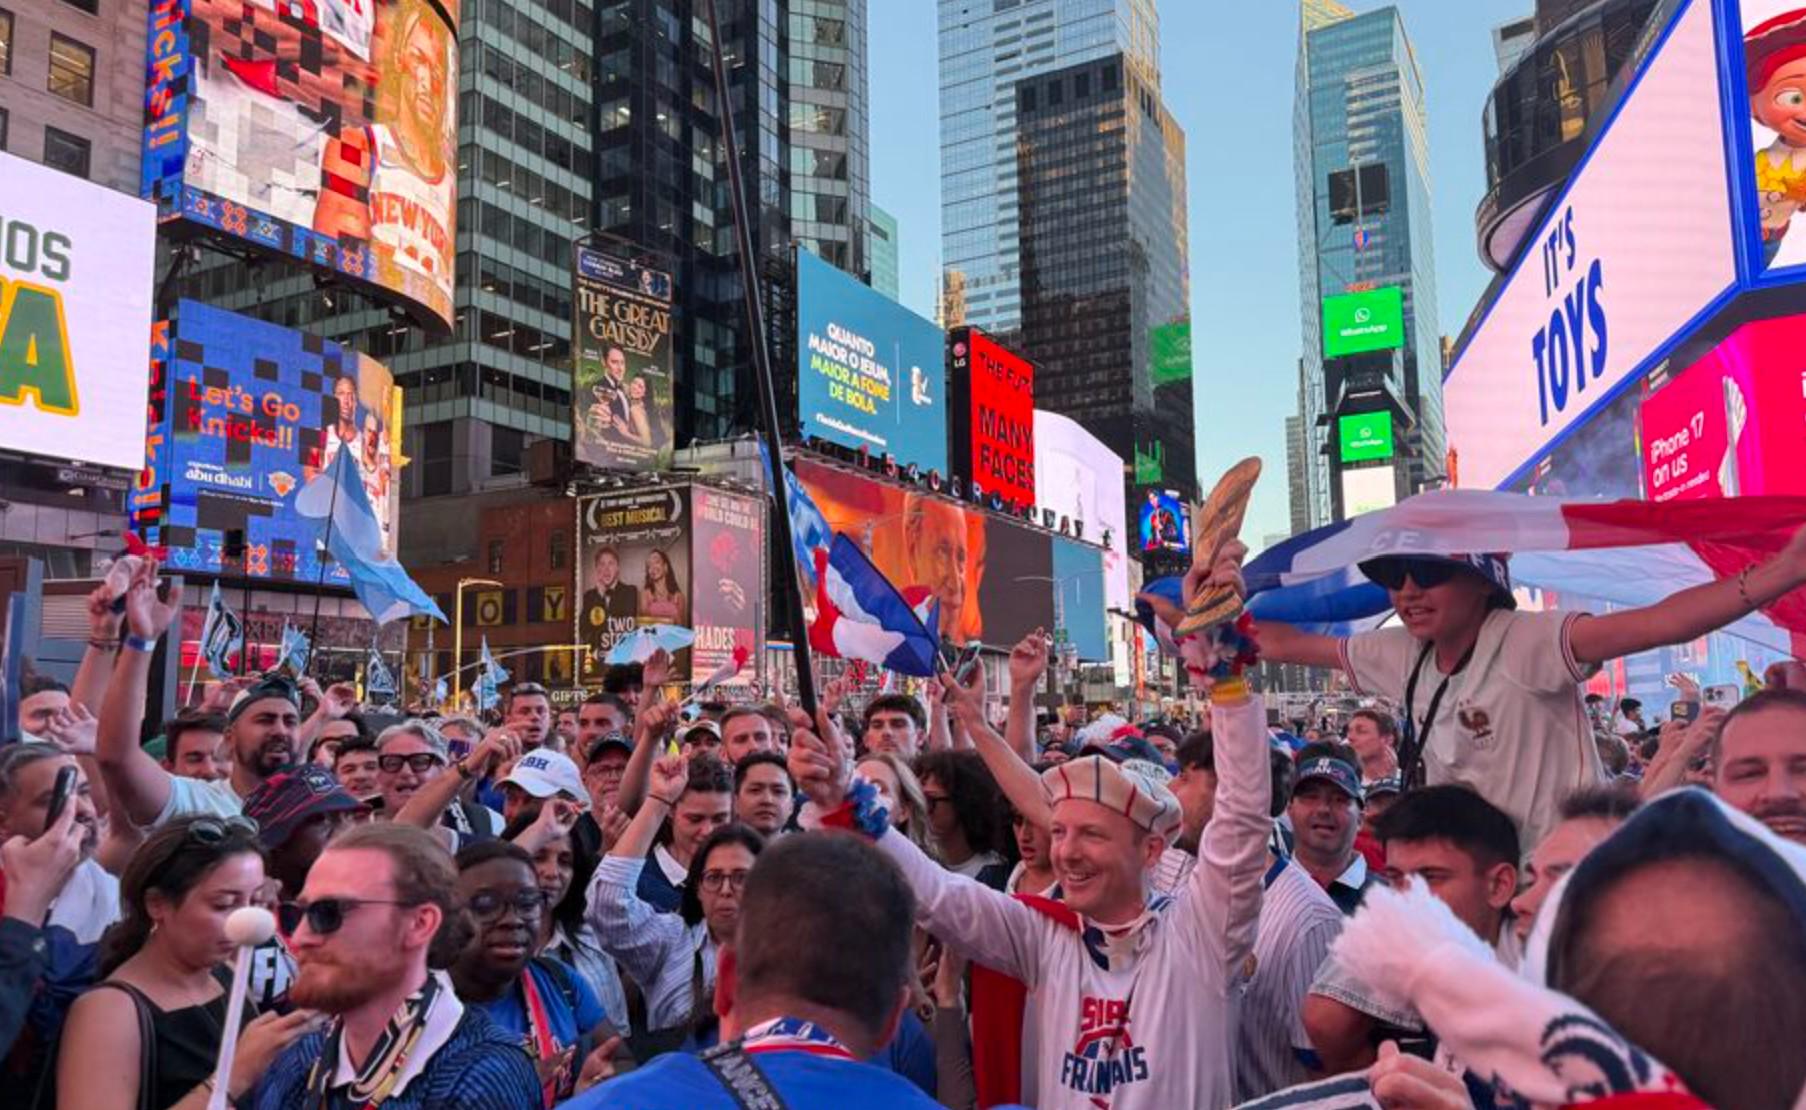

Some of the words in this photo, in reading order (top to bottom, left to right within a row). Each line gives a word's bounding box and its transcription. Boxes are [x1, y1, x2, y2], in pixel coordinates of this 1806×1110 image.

[0, 216, 72, 282] OS
[1543, 205, 1576, 298] IT'S
[579, 286, 610, 318] THE
[613, 299, 671, 335] GREAT
[0, 275, 80, 418] A
[590, 315, 661, 353] GATSBY
[827, 322, 875, 358] QUANTO
[1340, 323, 1388, 337] WhatsApp
[1532, 258, 1607, 428] TOYS
[808, 332, 848, 366] MAIOR
[848, 352, 860, 369] O
[954, 360, 966, 368] LG
[979, 351, 1004, 382] THE
[811, 353, 850, 386] MAIOR
[861, 376, 890, 403] FOME
[829, 379, 844, 402] DE
[188, 374, 254, 414] Let's
[261, 391, 301, 422] Go
[186, 405, 293, 450] Knicks!!
[979, 402, 1034, 455] MANY
[1650, 427, 1690, 465] iPhone
[1690, 410, 1705, 440] 17
[186, 468, 213, 482] abu
[214, 472, 253, 490] dhabi
[980, 441, 1035, 494] FACES
[1653, 463, 1670, 489] on
[1671, 453, 1688, 478] us
[626, 506, 667, 525] MUSICAL
[608, 615, 635, 632] two
[552, 690, 588, 702] GIFTS
